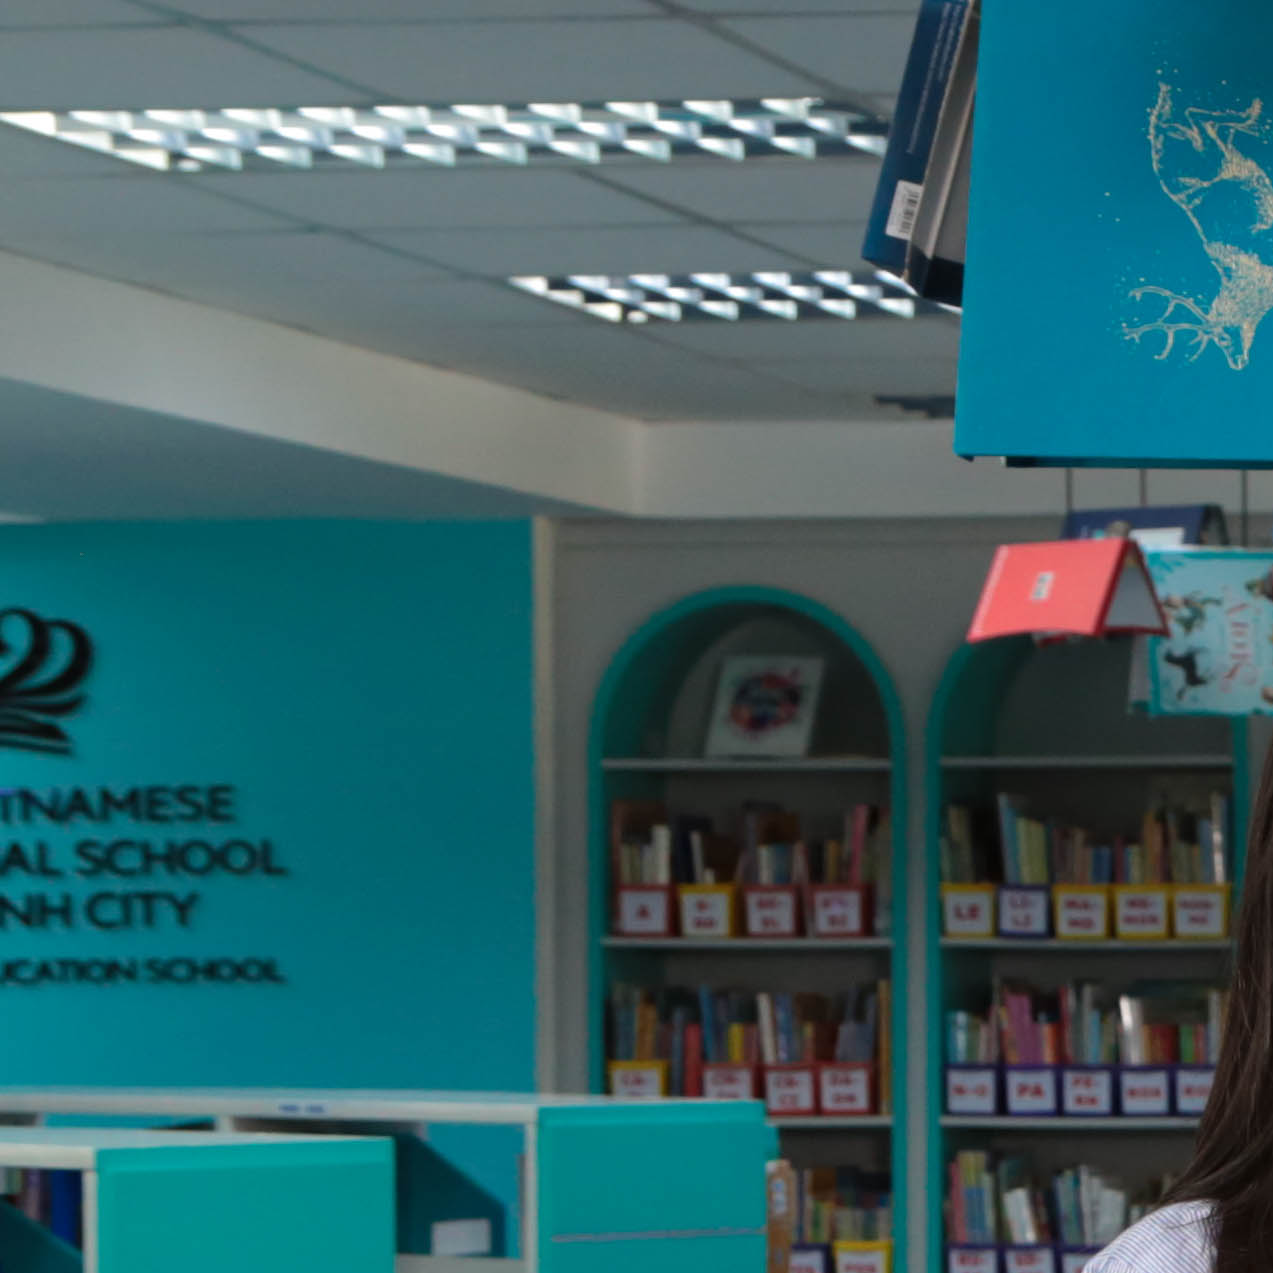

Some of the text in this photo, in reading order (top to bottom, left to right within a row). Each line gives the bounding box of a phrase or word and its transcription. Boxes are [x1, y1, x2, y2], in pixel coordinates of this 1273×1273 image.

[75, 840, 289, 878] SCHOOL
[86, 892, 201, 930] CITY
[145, 959, 286, 986] SCHOOL
